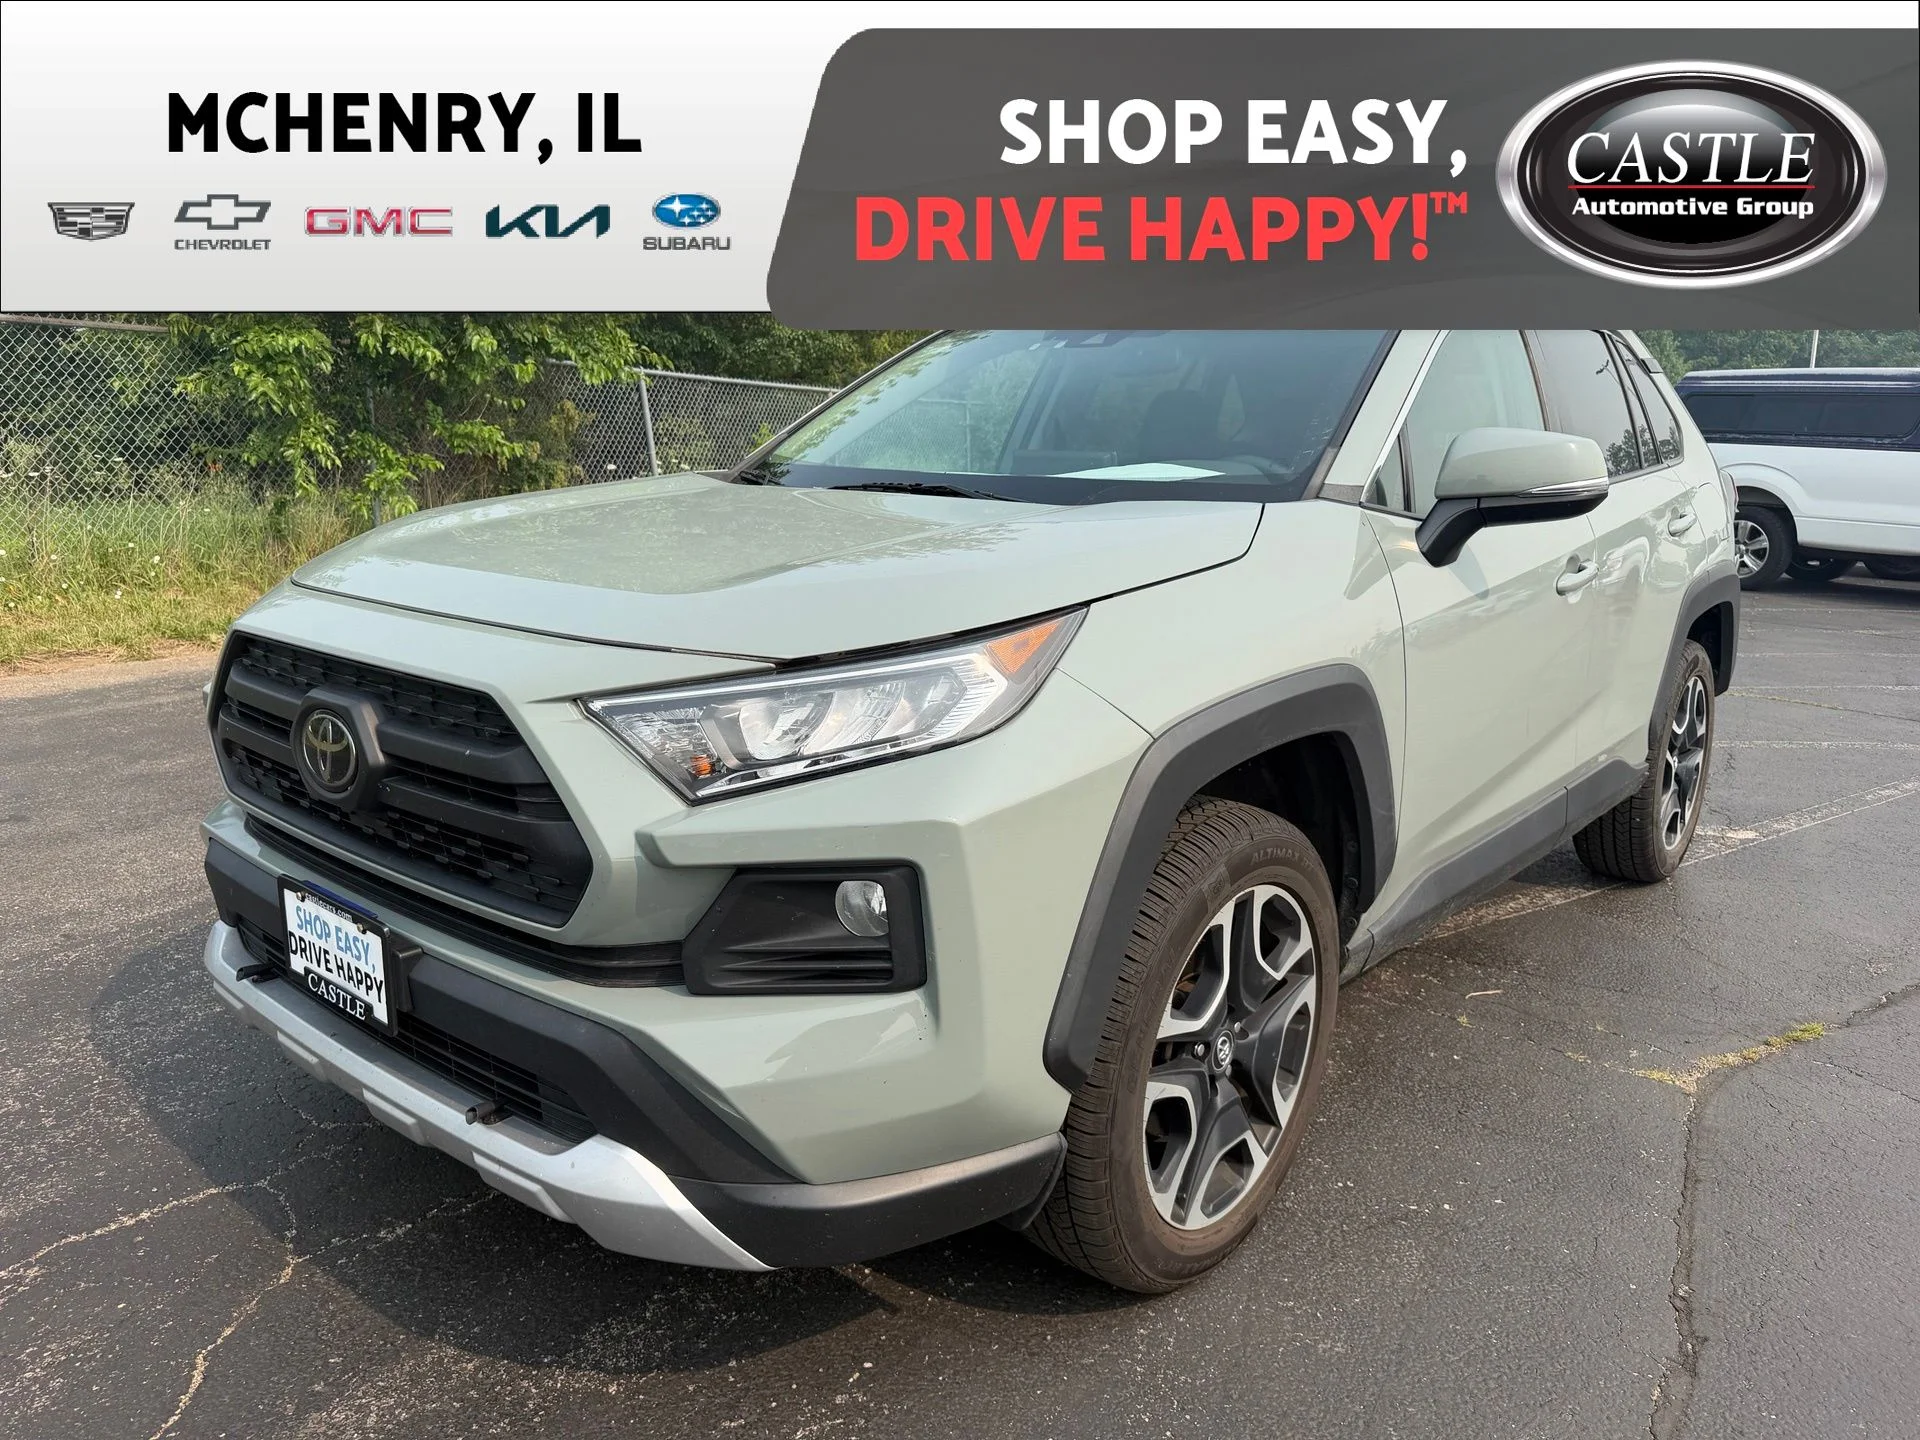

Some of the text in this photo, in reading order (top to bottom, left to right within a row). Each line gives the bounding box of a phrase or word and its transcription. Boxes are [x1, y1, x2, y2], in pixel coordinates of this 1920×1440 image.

[295, 905, 331, 943] SHOP
[288, 930, 384, 1004] DRIVE HAPPY
[308, 973, 366, 1020] CASTLE
